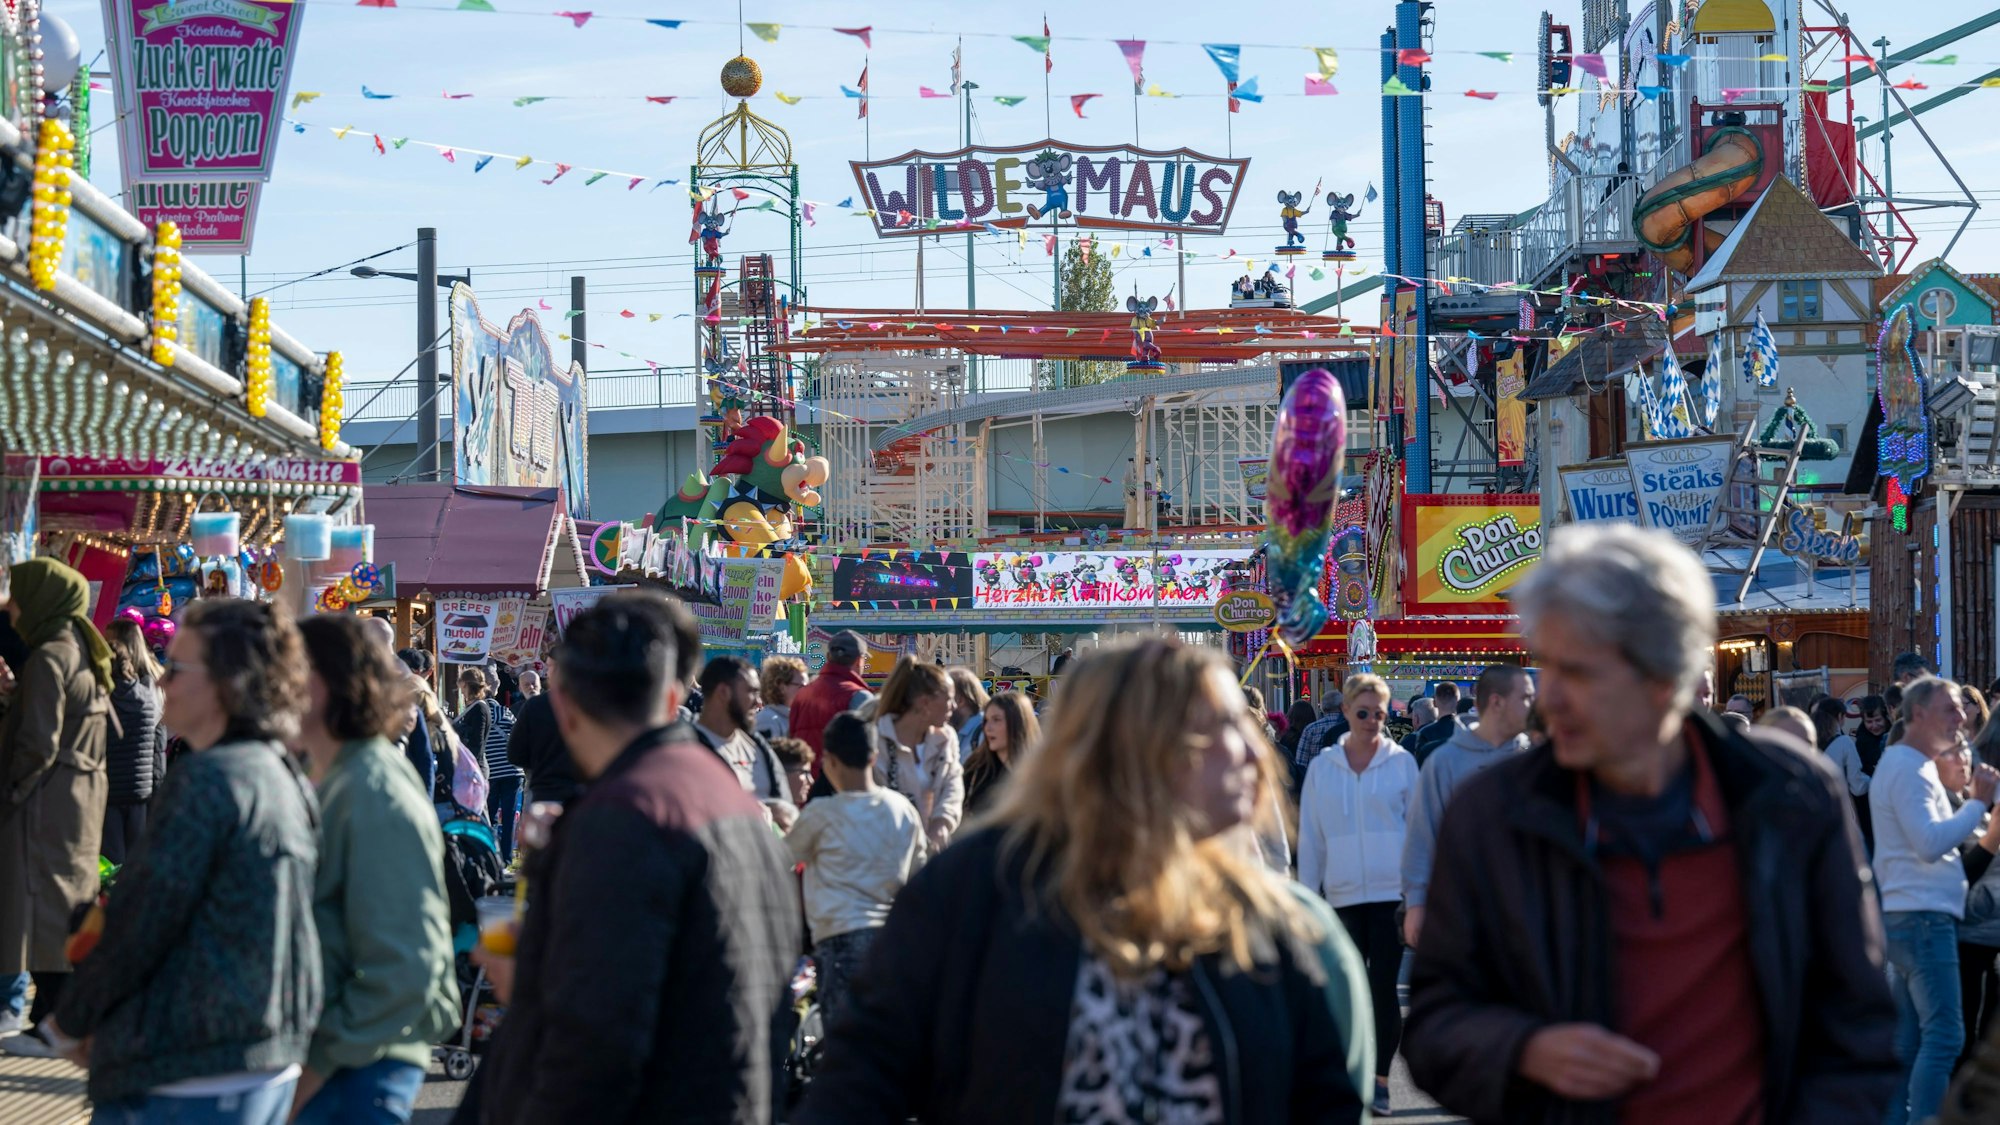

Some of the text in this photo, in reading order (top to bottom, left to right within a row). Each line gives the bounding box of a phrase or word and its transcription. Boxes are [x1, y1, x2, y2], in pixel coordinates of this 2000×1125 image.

[212, 0, 258, 18] Street
[176, 24, 243, 38] Köstliche
[134, 38, 283, 91] Zuckerwatte
[160, 92, 250, 110] Knackfrisches
[148, 107, 262, 168] Popcorn
[866, 157, 1233, 230] WILDE MAUS
[163, 454, 345, 482] Zuckerwatte
[1668, 463, 1699, 476] Saftige
[1643, 469, 1724, 493] Steaks
[1463, 516, 1517, 552] Don
[1443, 523, 1541, 590] Churro
[974, 583, 1063, 604] Herzlich
[1072, 582, 1209, 606] Willkommen
[1233, 596, 1255, 609] Don
[442, 600, 491, 614] CRÊPES
[691, 601, 744, 620] Blumenkohl
[1217, 603, 1271, 623] Churros
[1342, 607, 1369, 620] POLICE
[444, 627, 485, 639] nutella
